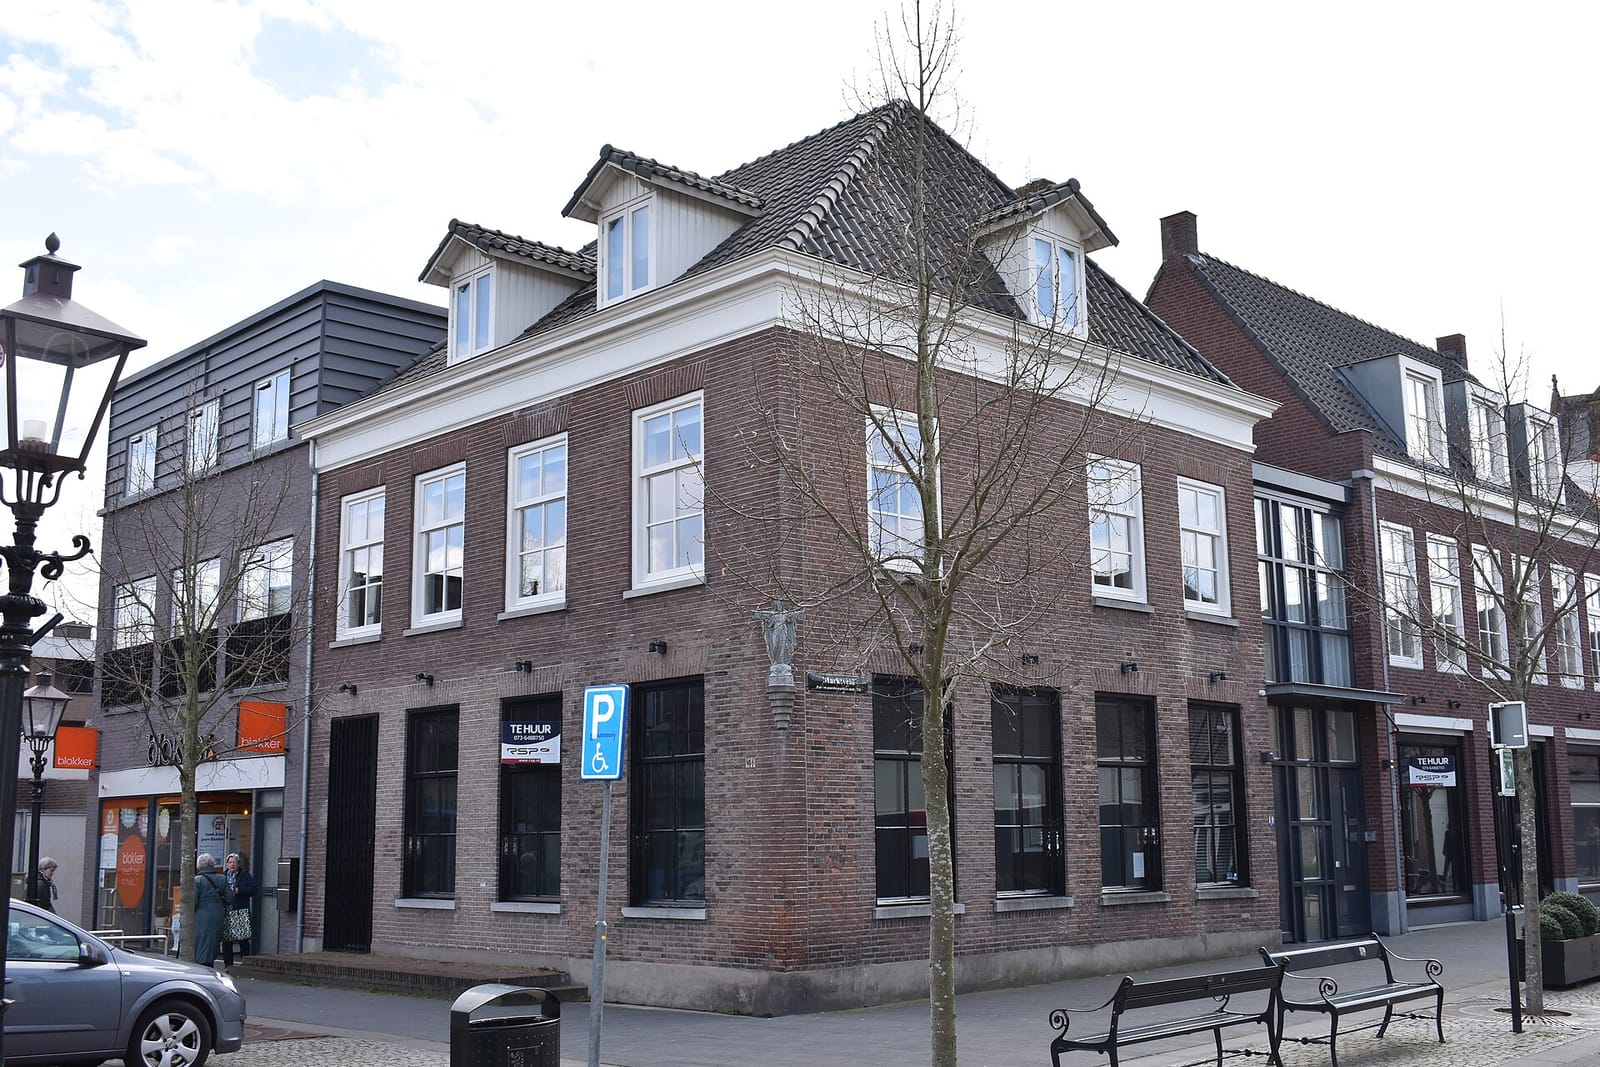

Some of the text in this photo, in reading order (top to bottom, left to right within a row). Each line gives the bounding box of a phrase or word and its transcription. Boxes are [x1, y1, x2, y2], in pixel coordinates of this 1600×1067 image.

[592, 694, 614, 740] P
[510, 724, 551, 734] TE HUUR
[507, 747, 539, 755] RSP
